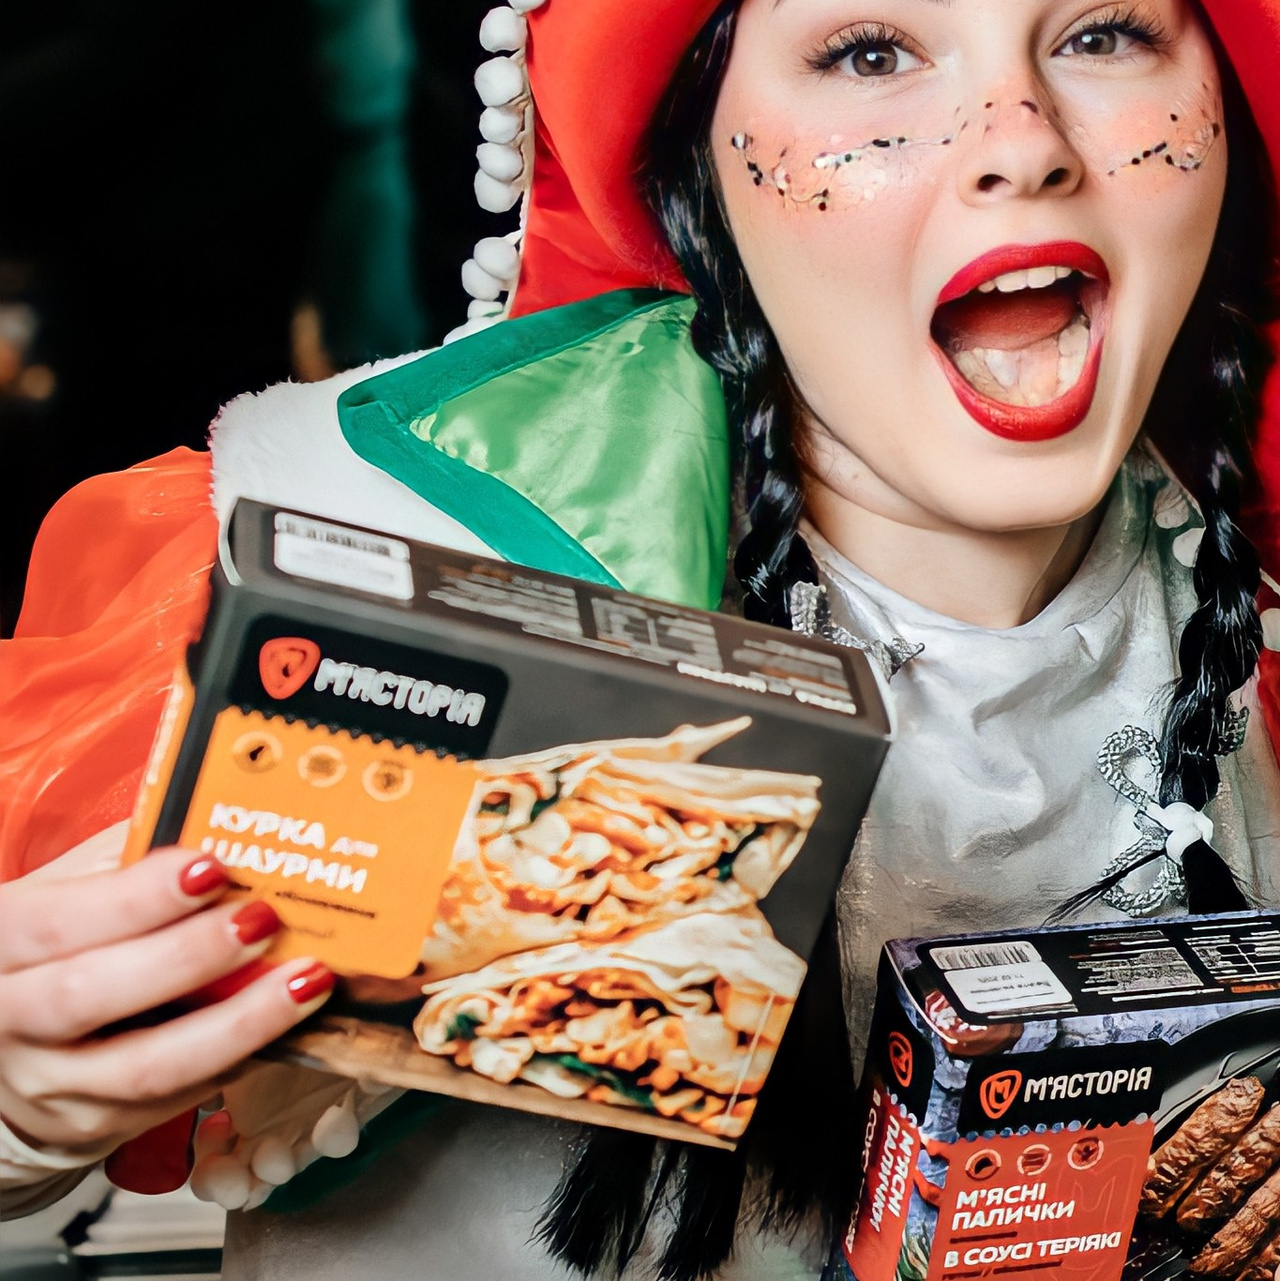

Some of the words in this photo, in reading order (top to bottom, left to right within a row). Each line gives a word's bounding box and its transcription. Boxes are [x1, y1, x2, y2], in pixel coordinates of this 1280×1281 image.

[1023, 1066, 1152, 1103] М'ЯСТОРІЯ
[956, 1182, 1047, 1210] М'ЯСНІ
[951, 1200, 1075, 1231] ПАЛИЧКИ
[943, 1250, 959, 1269] В
[963, 1241, 1032, 1263] СОУСІ
[1037, 1231, 1122, 1258] ТЕРІЯКІ
